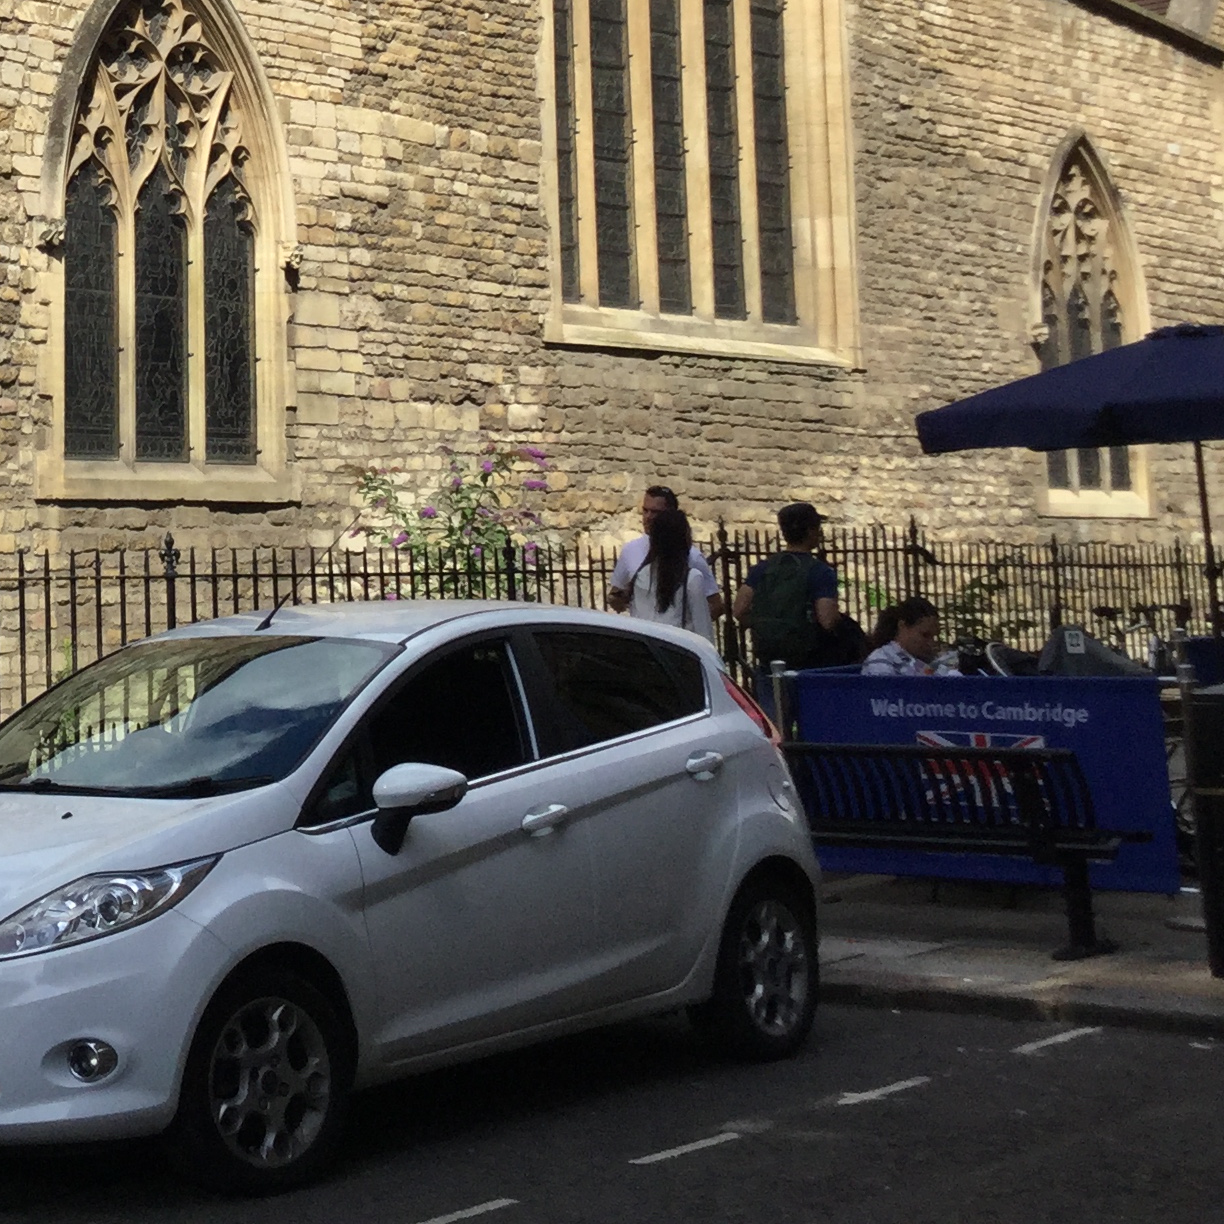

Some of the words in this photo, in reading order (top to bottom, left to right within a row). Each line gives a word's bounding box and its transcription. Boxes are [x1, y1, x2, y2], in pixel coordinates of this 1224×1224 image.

[870, 698, 956, 718] Welcome
[958, 701, 978, 719] to
[981, 700, 1089, 727] Cambridge
